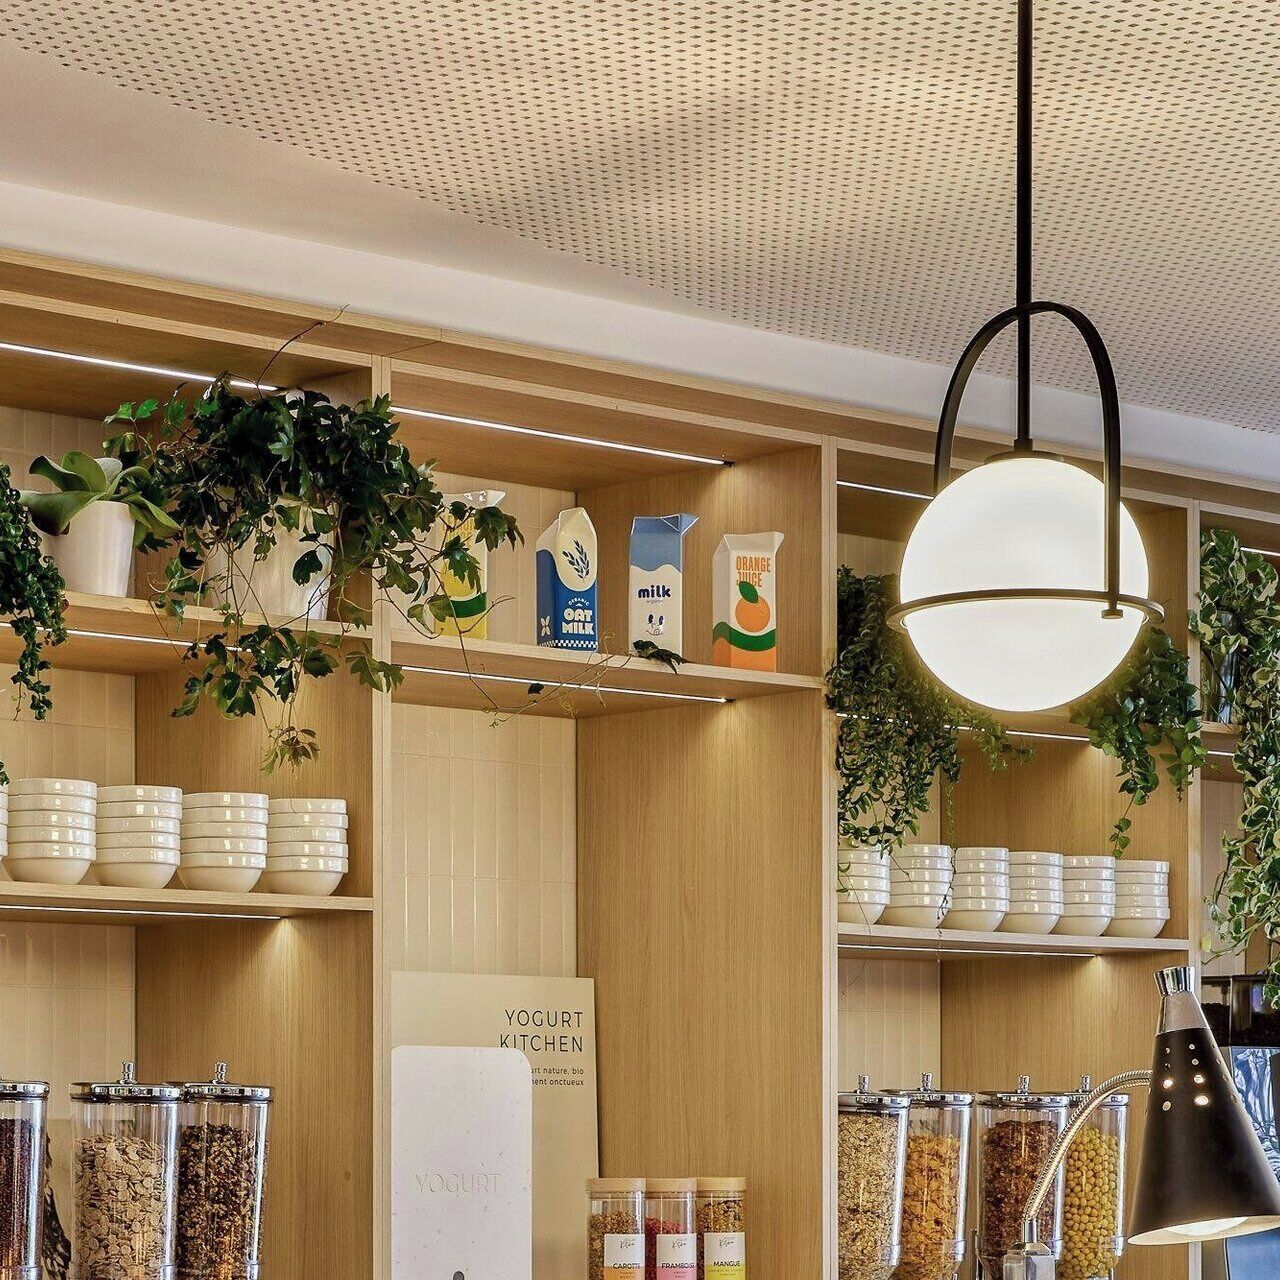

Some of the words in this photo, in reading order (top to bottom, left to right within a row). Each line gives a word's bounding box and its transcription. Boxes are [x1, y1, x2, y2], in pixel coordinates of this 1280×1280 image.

[736, 556, 771, 572] ORANGE
[736, 571, 762, 587] JUICE
[638, 584, 671, 598] milk
[563, 608, 592, 621] OAT
[562, 621, 595, 635] MILK
[505, 1009, 583, 1028] YOGURT
[500, 1034, 583, 1052] KITCHEN
[543, 1067, 570, 1075] nature,
[572, 1067, 584, 1075] bio
[549, 1078, 584, 1086] onctueux
[415, 1173, 501, 1194] YOGURT
[613, 1262, 641, 1270] CAROTTE
